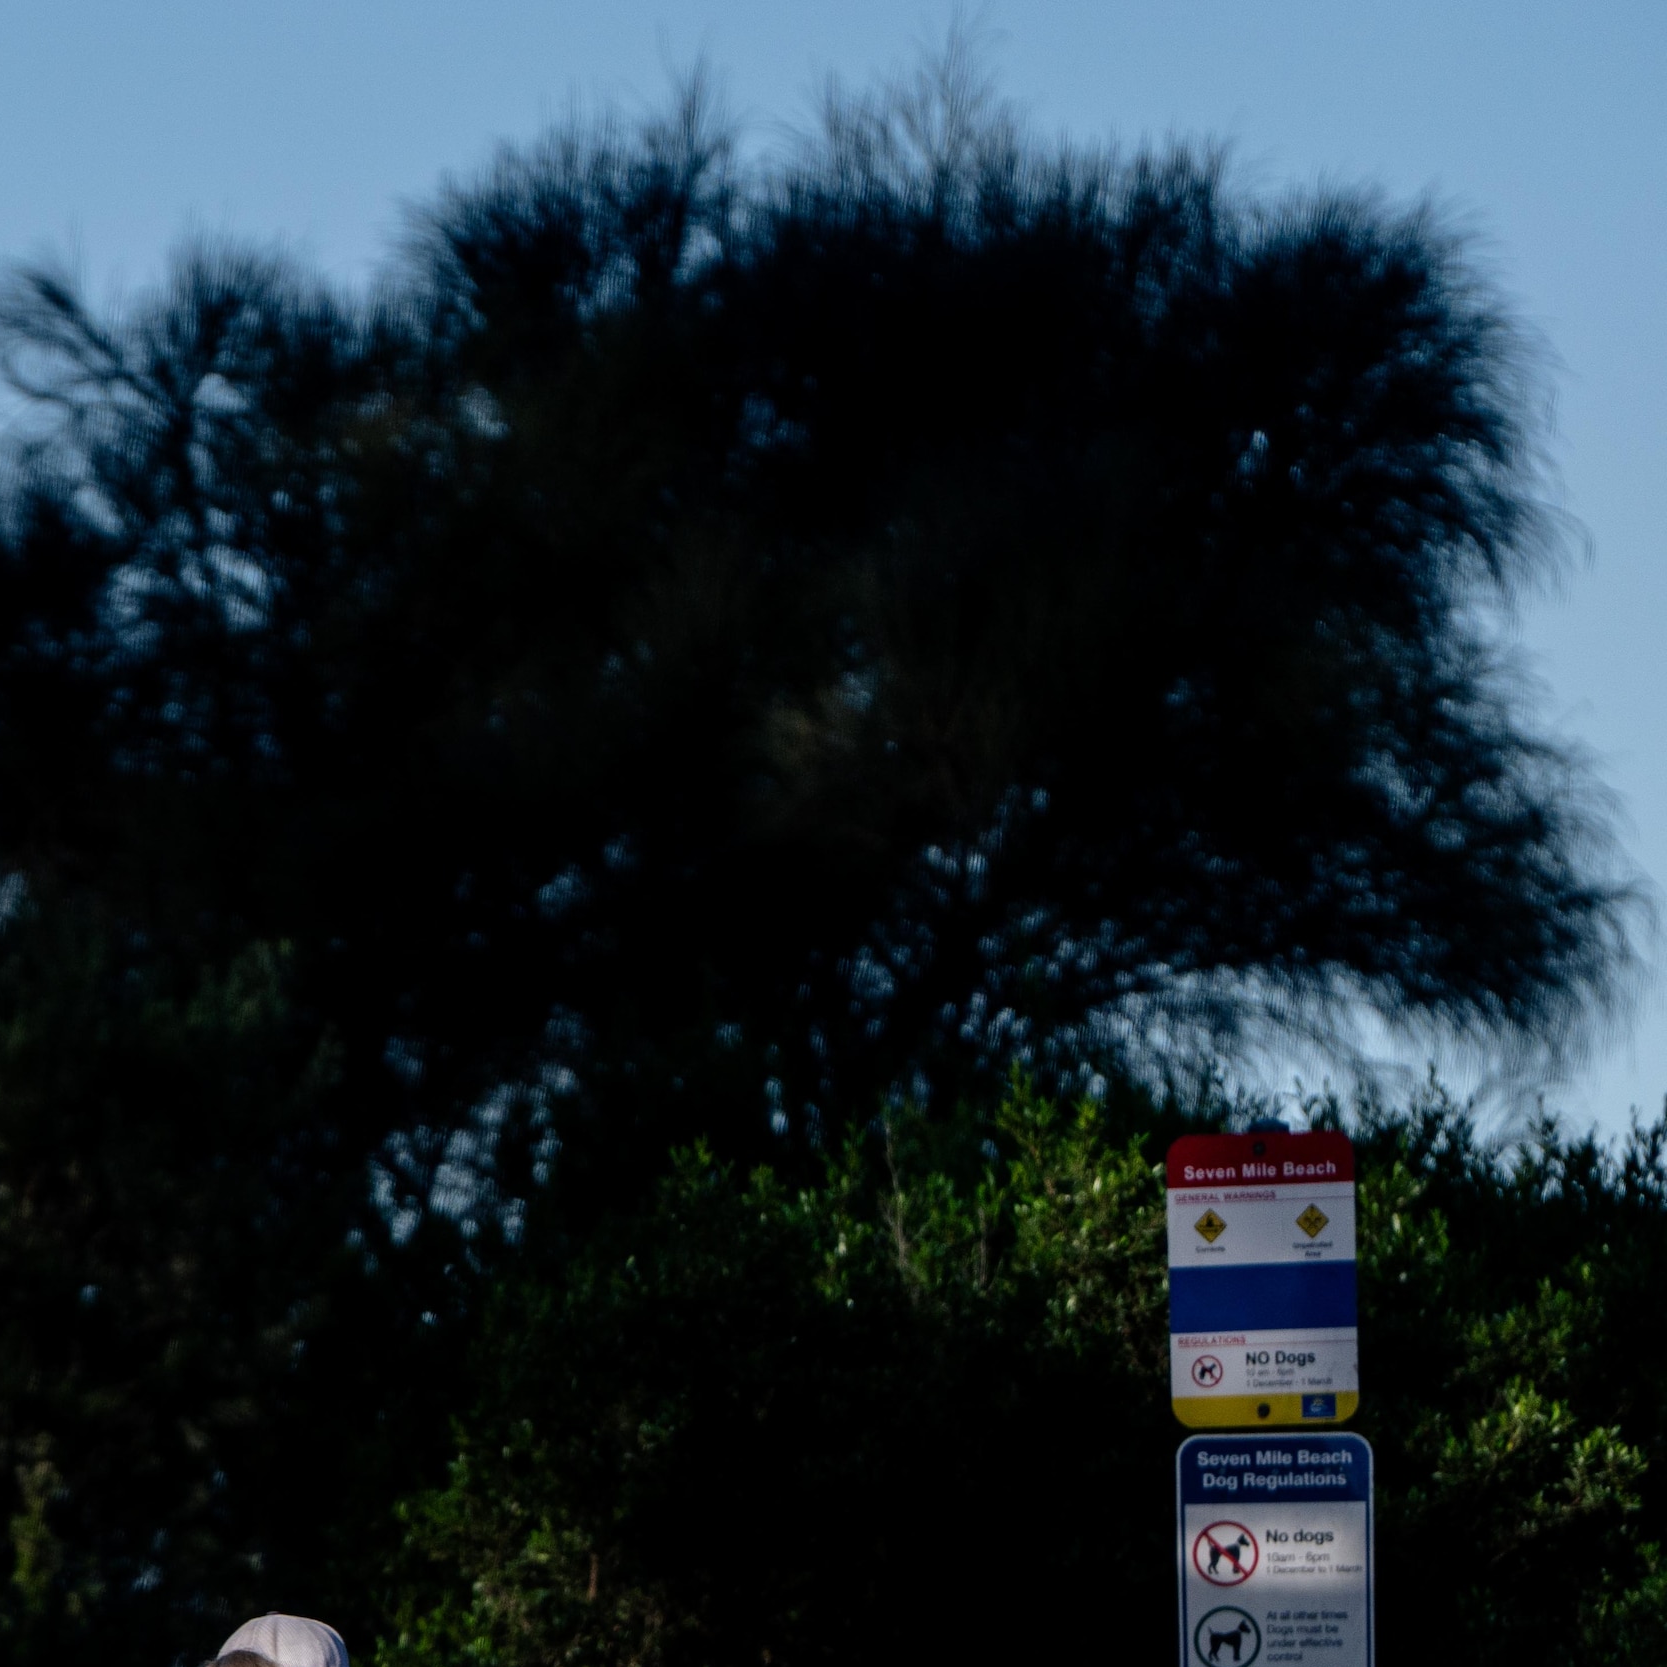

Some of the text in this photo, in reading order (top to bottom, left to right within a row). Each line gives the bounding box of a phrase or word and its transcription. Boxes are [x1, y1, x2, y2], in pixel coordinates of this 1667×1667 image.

[1184, 1161, 1336, 1181] Seven Mile Beach
[1224, 1190, 1276, 1202] WARNINGS
[1178, 1335, 1246, 1346] REGULATIONS
[1246, 1350, 1316, 1367] NO Dogs
[1253, 1378, 1293, 1388] December
[1197, 1449, 1352, 1467] Seven Mile Beach
[1202, 1470, 1347, 1490] Dog Regulations
[1266, 1529, 1334, 1545] No dogs
[1273, 1565, 1315, 1574] December
[1266, 1624, 1339, 1635] Dogs must be
[1266, 1639, 1295, 1648] under
[1266, 1651, 1303, 1661] control
